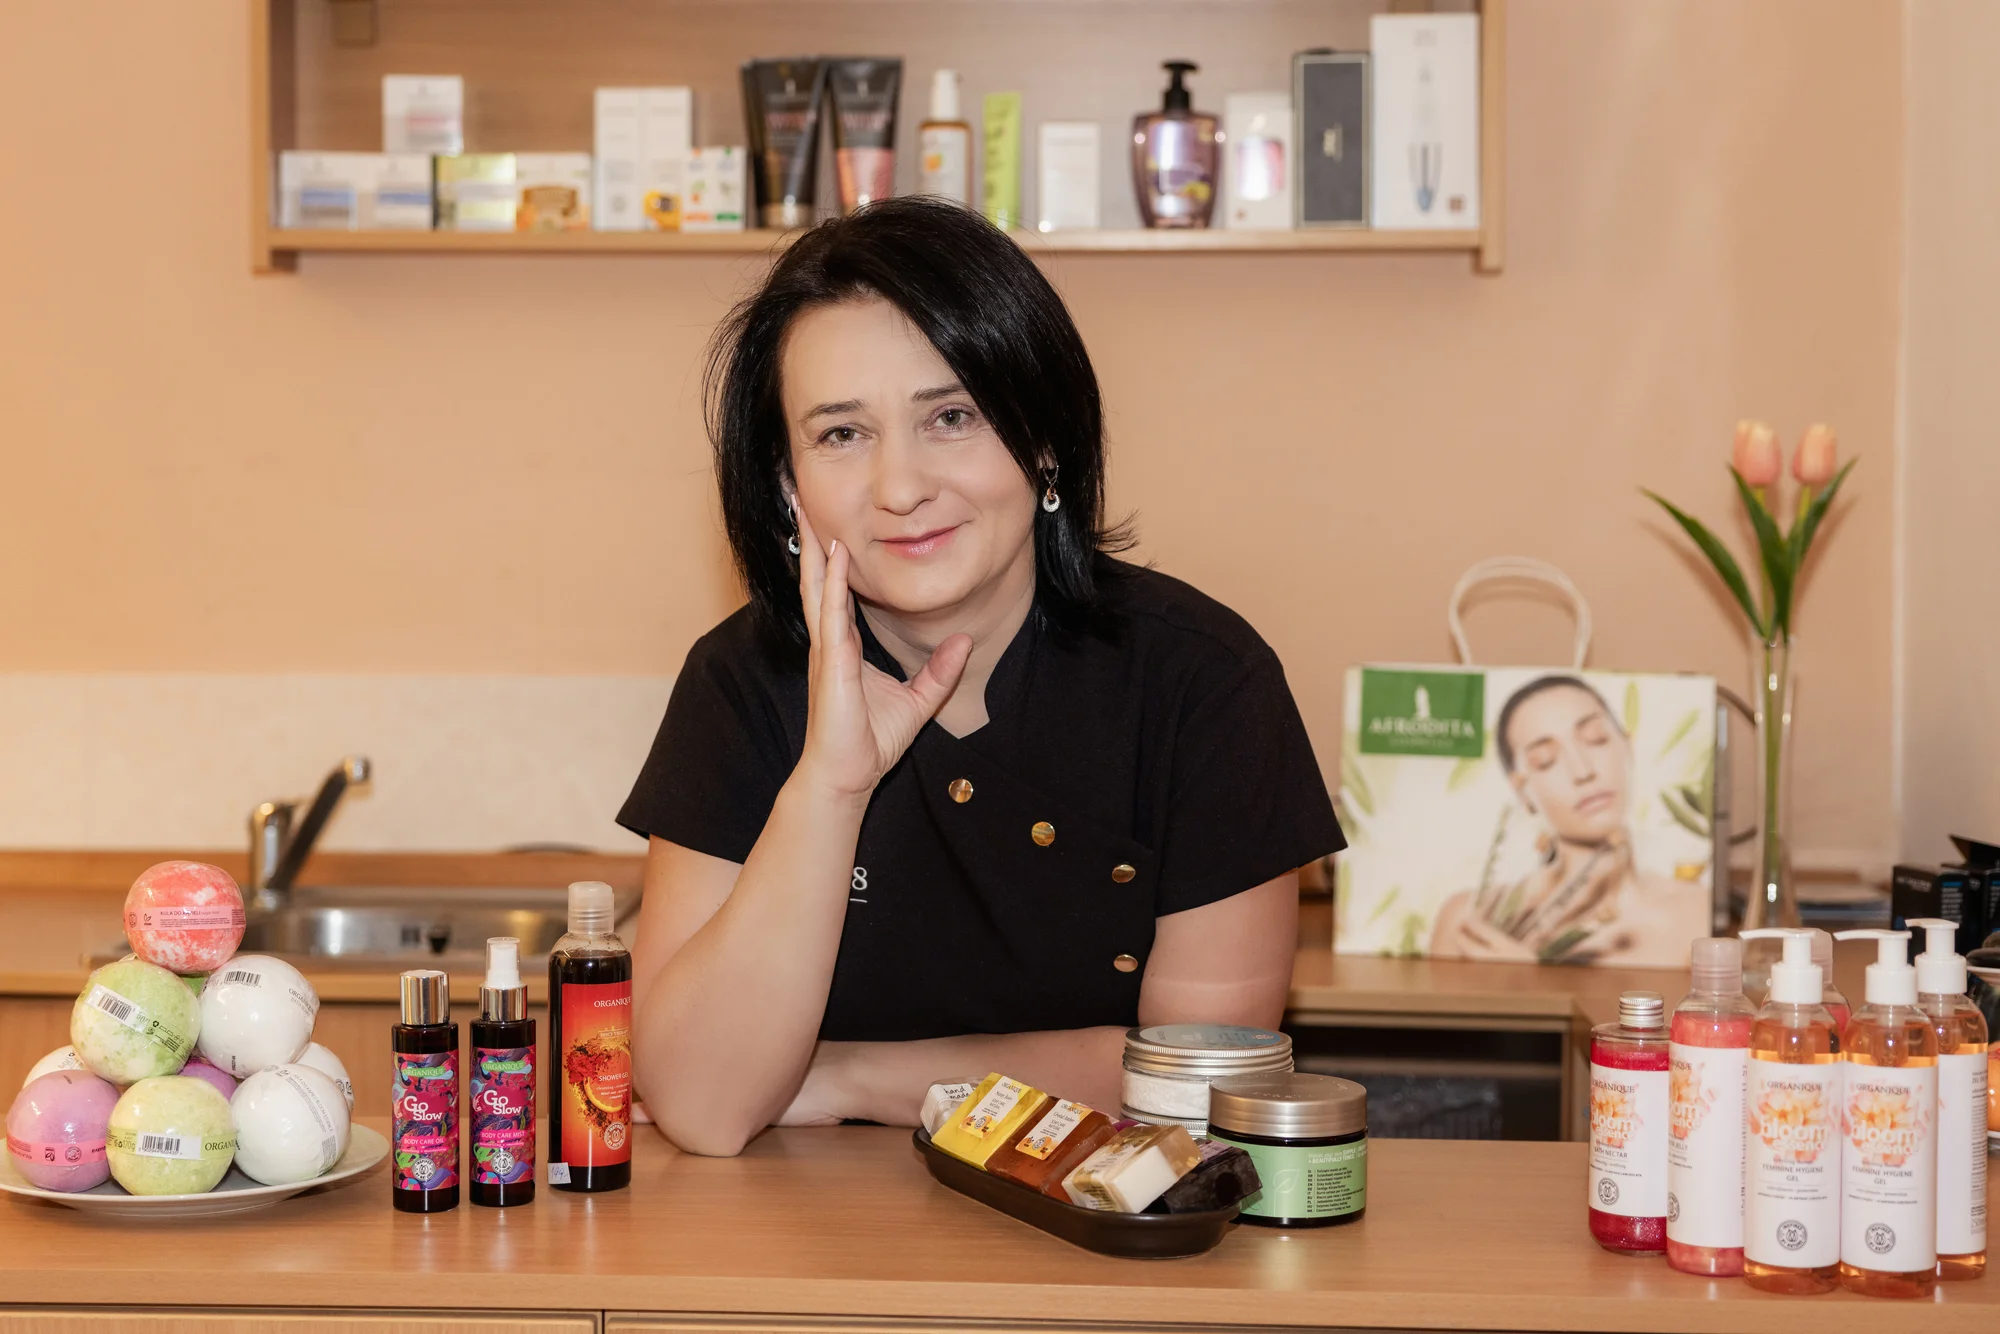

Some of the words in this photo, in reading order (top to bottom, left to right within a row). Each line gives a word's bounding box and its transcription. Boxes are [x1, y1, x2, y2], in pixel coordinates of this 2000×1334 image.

[1369, 716, 1476, 739] AFRODITA
[851, 866, 868, 891] 8
[482, 1062, 524, 1071] ORGANIQUE
[402, 1068, 444, 1077] ORGANIQUE
[598, 1073, 621, 1082] SHOWER
[943, 1085, 966, 1095] hand
[1766, 1081, 1823, 1092] ORGANIQUE
[1856, 1083, 1910, 1096] ORGANIQUE
[403, 1095, 429, 1113] Go
[483, 1089, 509, 1108] Go
[413, 1110, 443, 1121] Slow
[493, 1106, 522, 1115] Slow
[1605, 1149, 1628, 1159] NECTAR
[1762, 1163, 1793, 1173] FEMININE
[1796, 1166, 1824, 1174] HYGIENE
[1852, 1165, 1881, 1176] FEMININE
